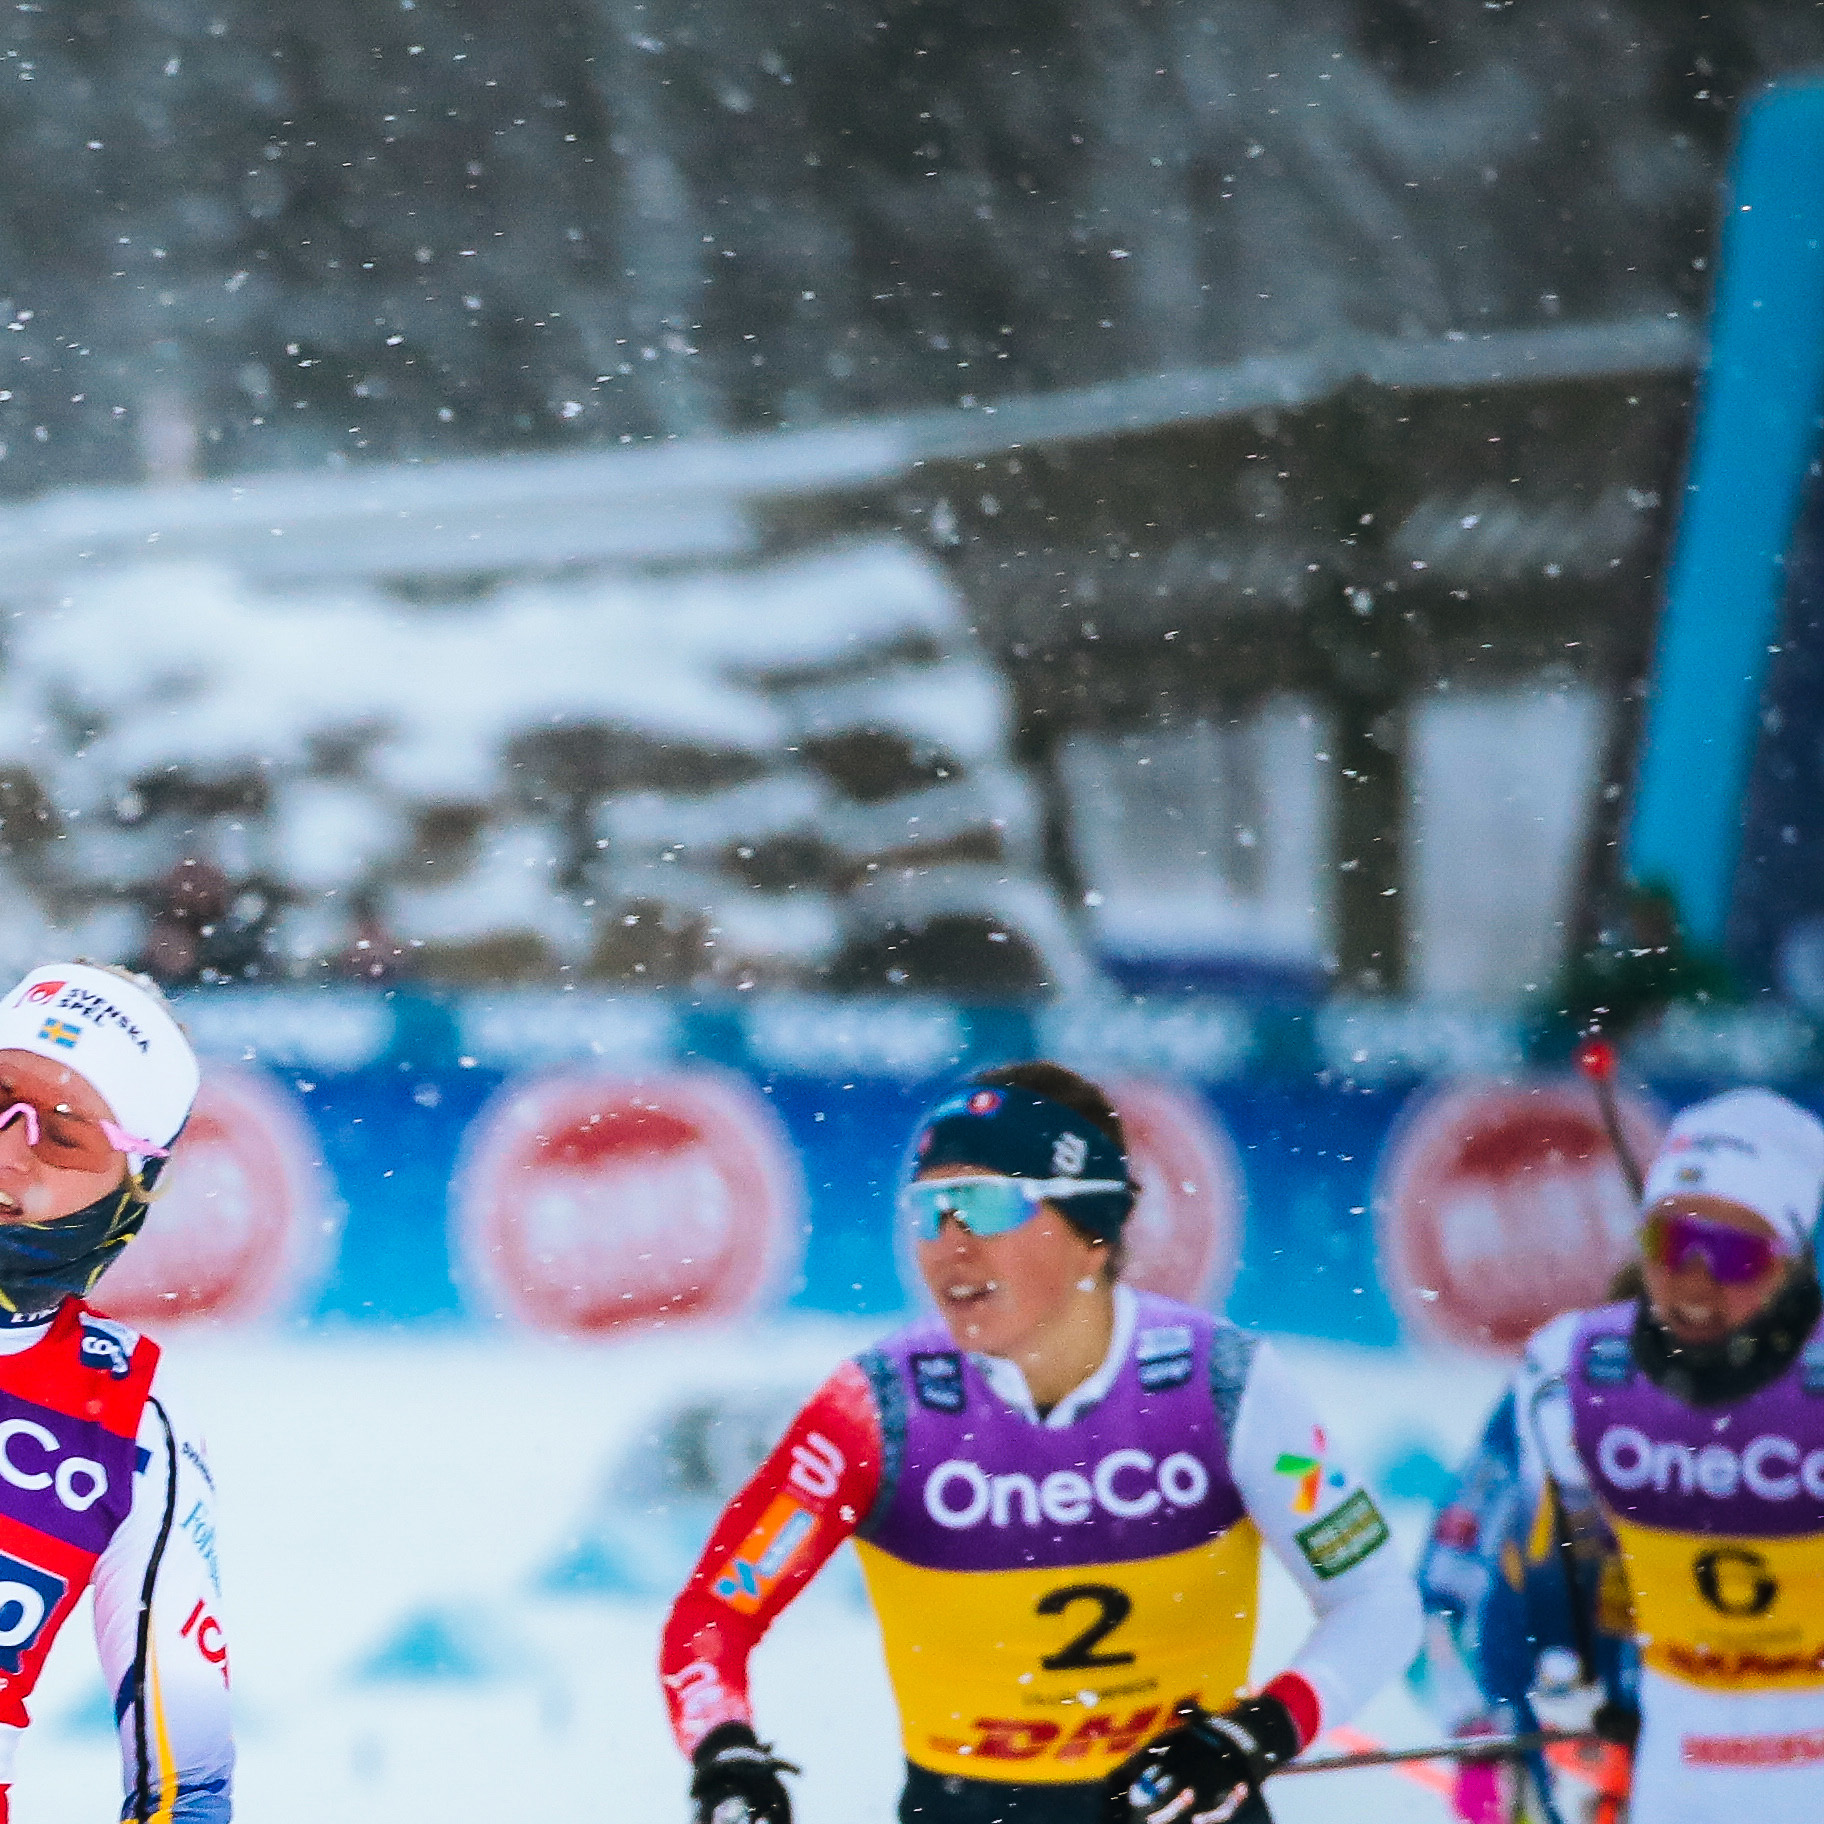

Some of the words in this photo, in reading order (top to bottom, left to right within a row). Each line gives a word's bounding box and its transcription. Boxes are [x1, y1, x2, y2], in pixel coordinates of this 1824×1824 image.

[56, 996, 106, 1029] SPEL
[67, 987, 152, 1055] SVENSKA
[923, 1448, 1209, 1530] OneCo
[1035, 1582, 1137, 1671] 2
